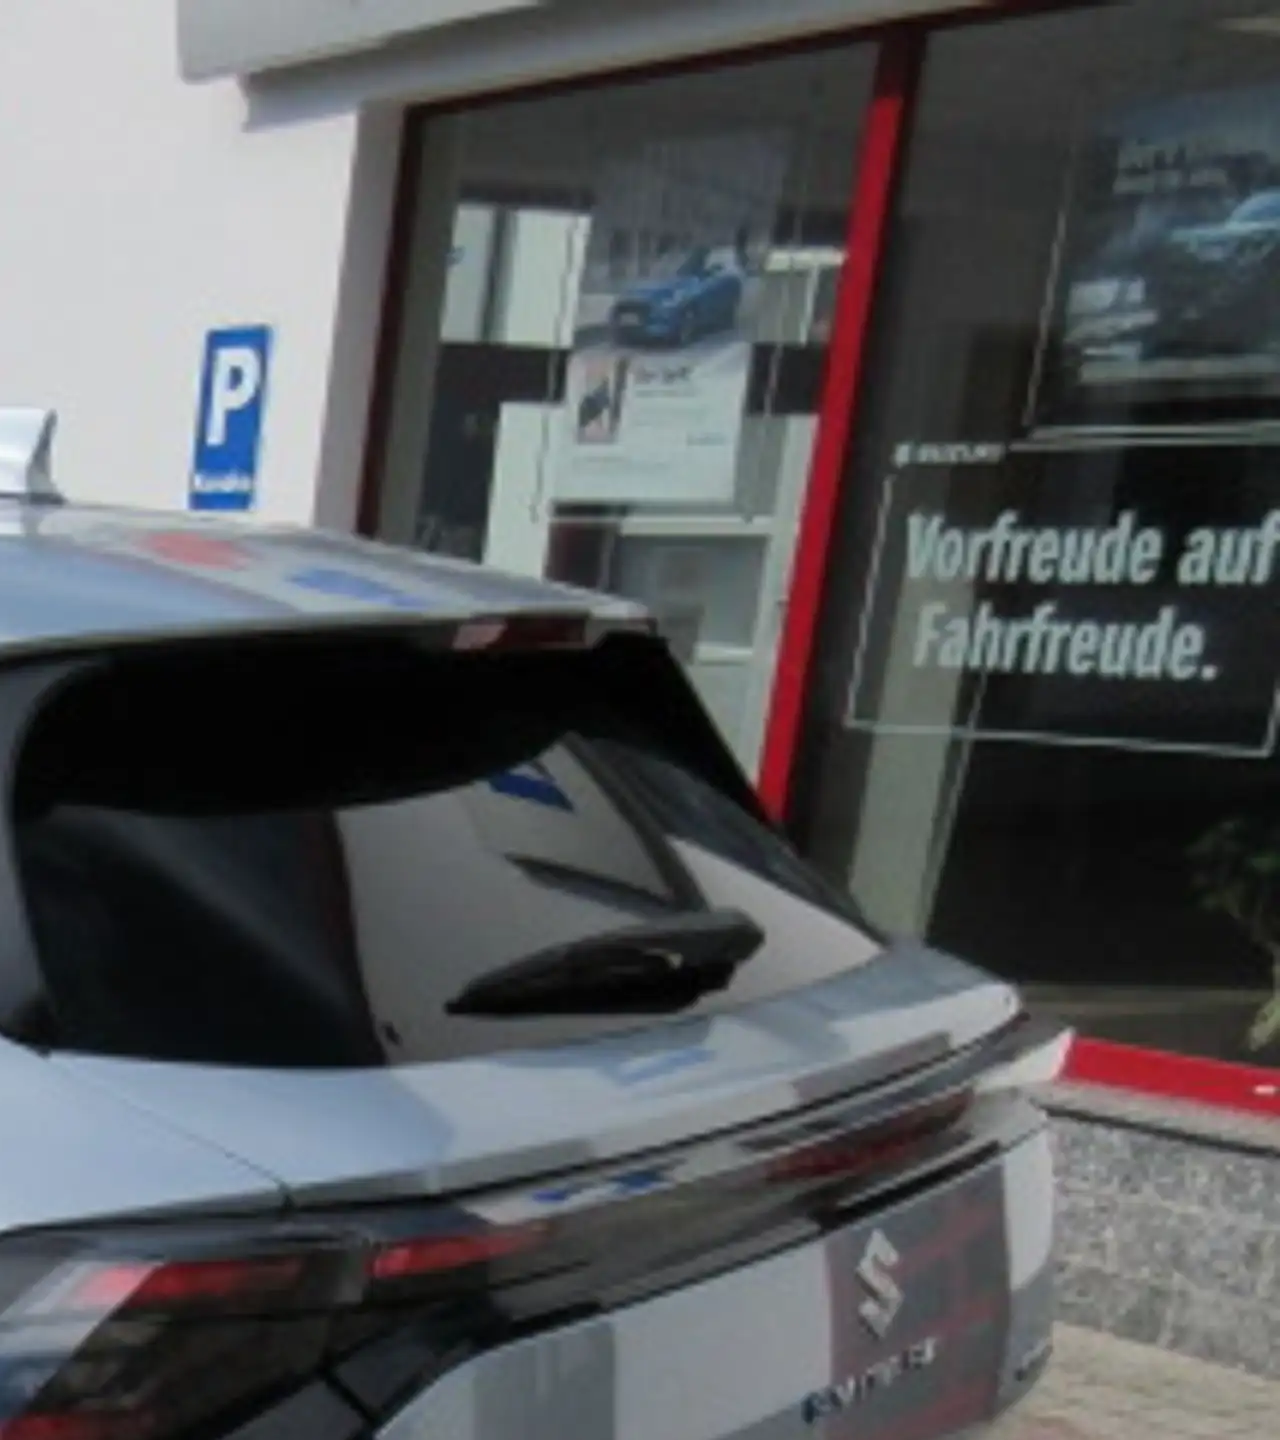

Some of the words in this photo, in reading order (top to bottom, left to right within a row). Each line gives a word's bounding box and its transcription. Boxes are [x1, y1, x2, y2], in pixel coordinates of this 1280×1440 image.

[206, 348, 260, 446] P
[906, 509, 1163, 584] Vorfreude
[1177, 509, 1280, 584] auf
[912, 602, 1219, 680] Fahrfreude.
